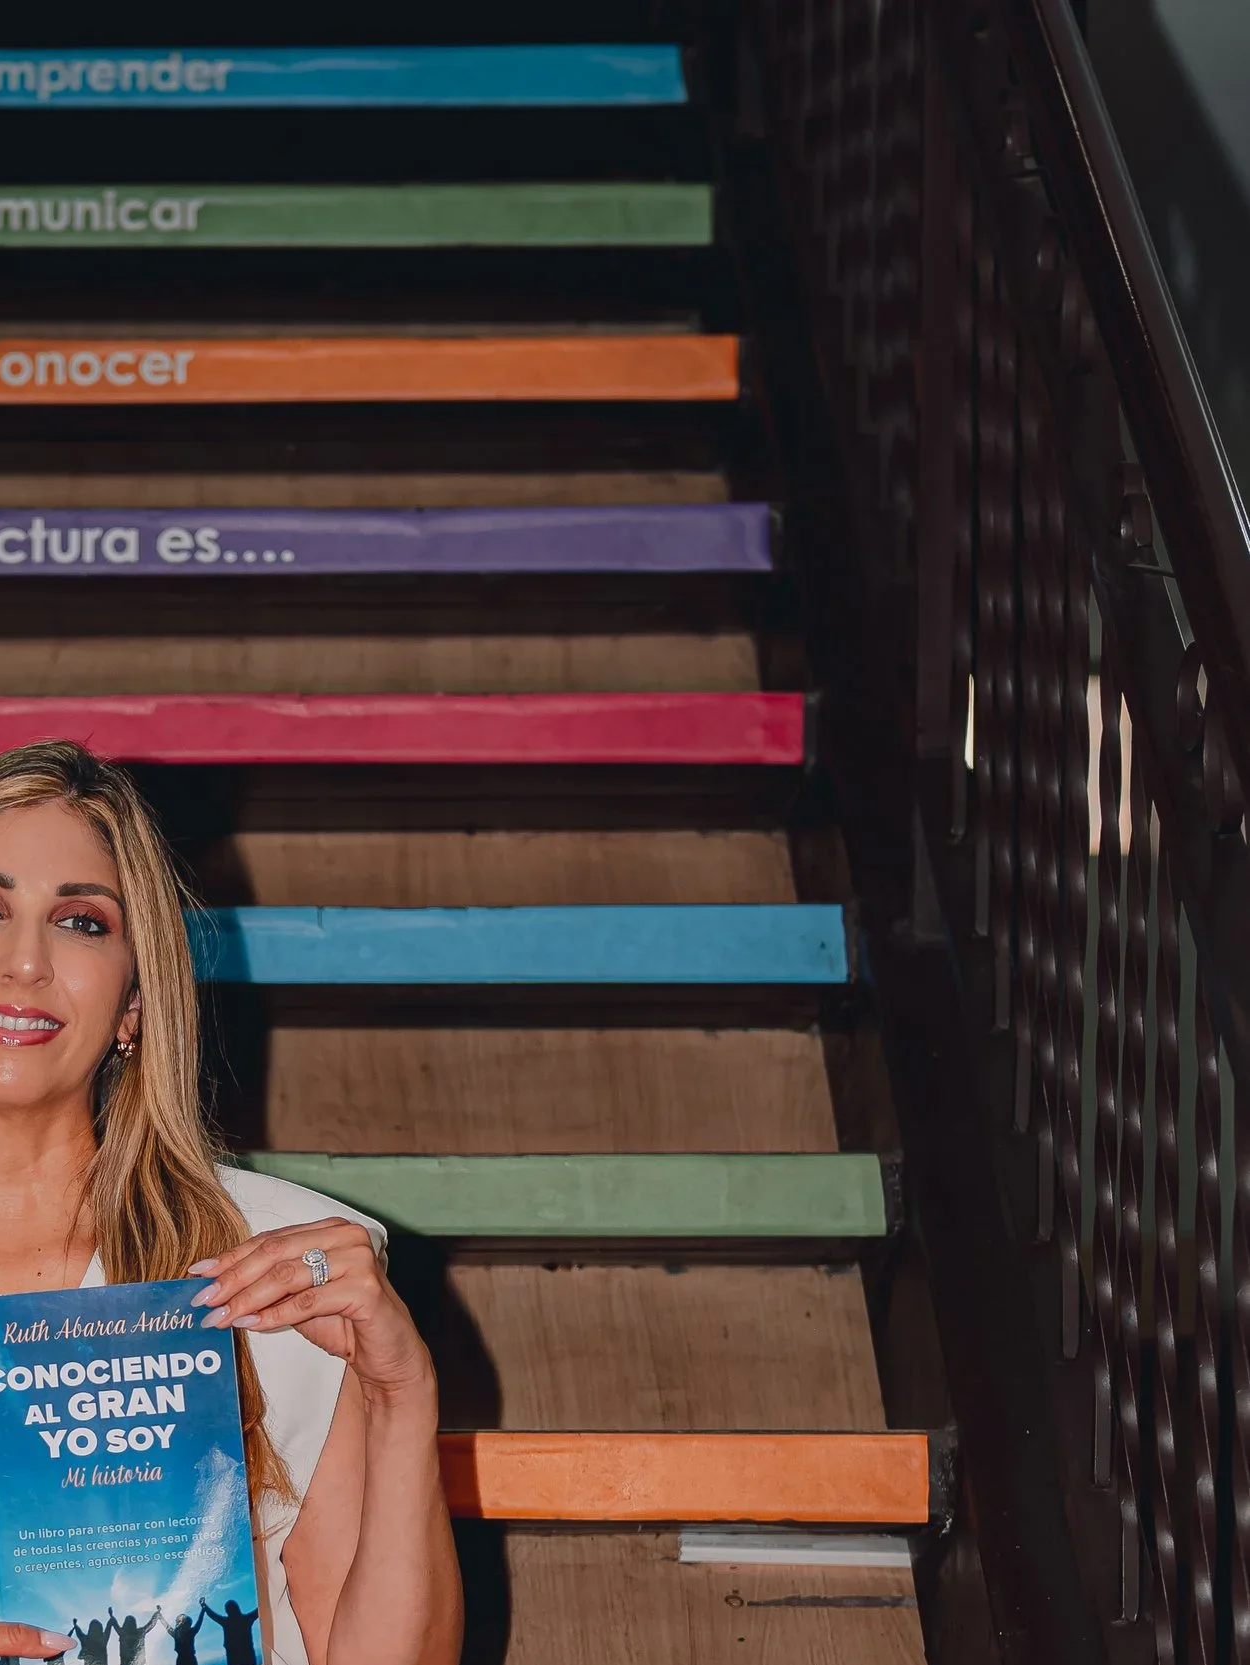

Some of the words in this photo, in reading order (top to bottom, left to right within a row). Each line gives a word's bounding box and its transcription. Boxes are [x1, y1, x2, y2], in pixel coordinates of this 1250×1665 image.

[156, 526, 296, 564] es....
[3, 1319, 50, 1344] Ruth
[54, 1316, 126, 1340] Abarca
[131, 1308, 194, 1334] Antón
[25, 1403, 61, 1425] AL
[67, 1384, 186, 1421] GRAN
[39, 1427, 98, 1459] YO
[106, 1424, 176, 1453] SOY
[61, 1466, 85, 1488] Mi
[92, 1461, 162, 1486] historia
[19, 1530, 35, 1540] Un
[38, 1528, 65, 1538] libro
[68, 1526, 94, 1538] para
[97, 1522, 140, 1534] resonar
[144, 1519, 165, 1529] con
[168, 1515, 215, 1527] lectores
[13, 1546, 28, 1557] de
[31, 1544, 63, 1556] todas
[66, 1541, 83, 1552] las
[86, 1538, 141, 1551] creencias
[144, 1536, 158, 1548] ya
[161, 1533, 188, 1544] sean
[192, 1530, 224, 1541] ateos
[14, 1564, 22, 1573] o
[25, 1559, 85, 1573] creyentes,
[88, 1553, 151, 1568] agnósticos
[153, 1552, 161, 1561] o
[164, 1545, 226, 1561] escépticos
